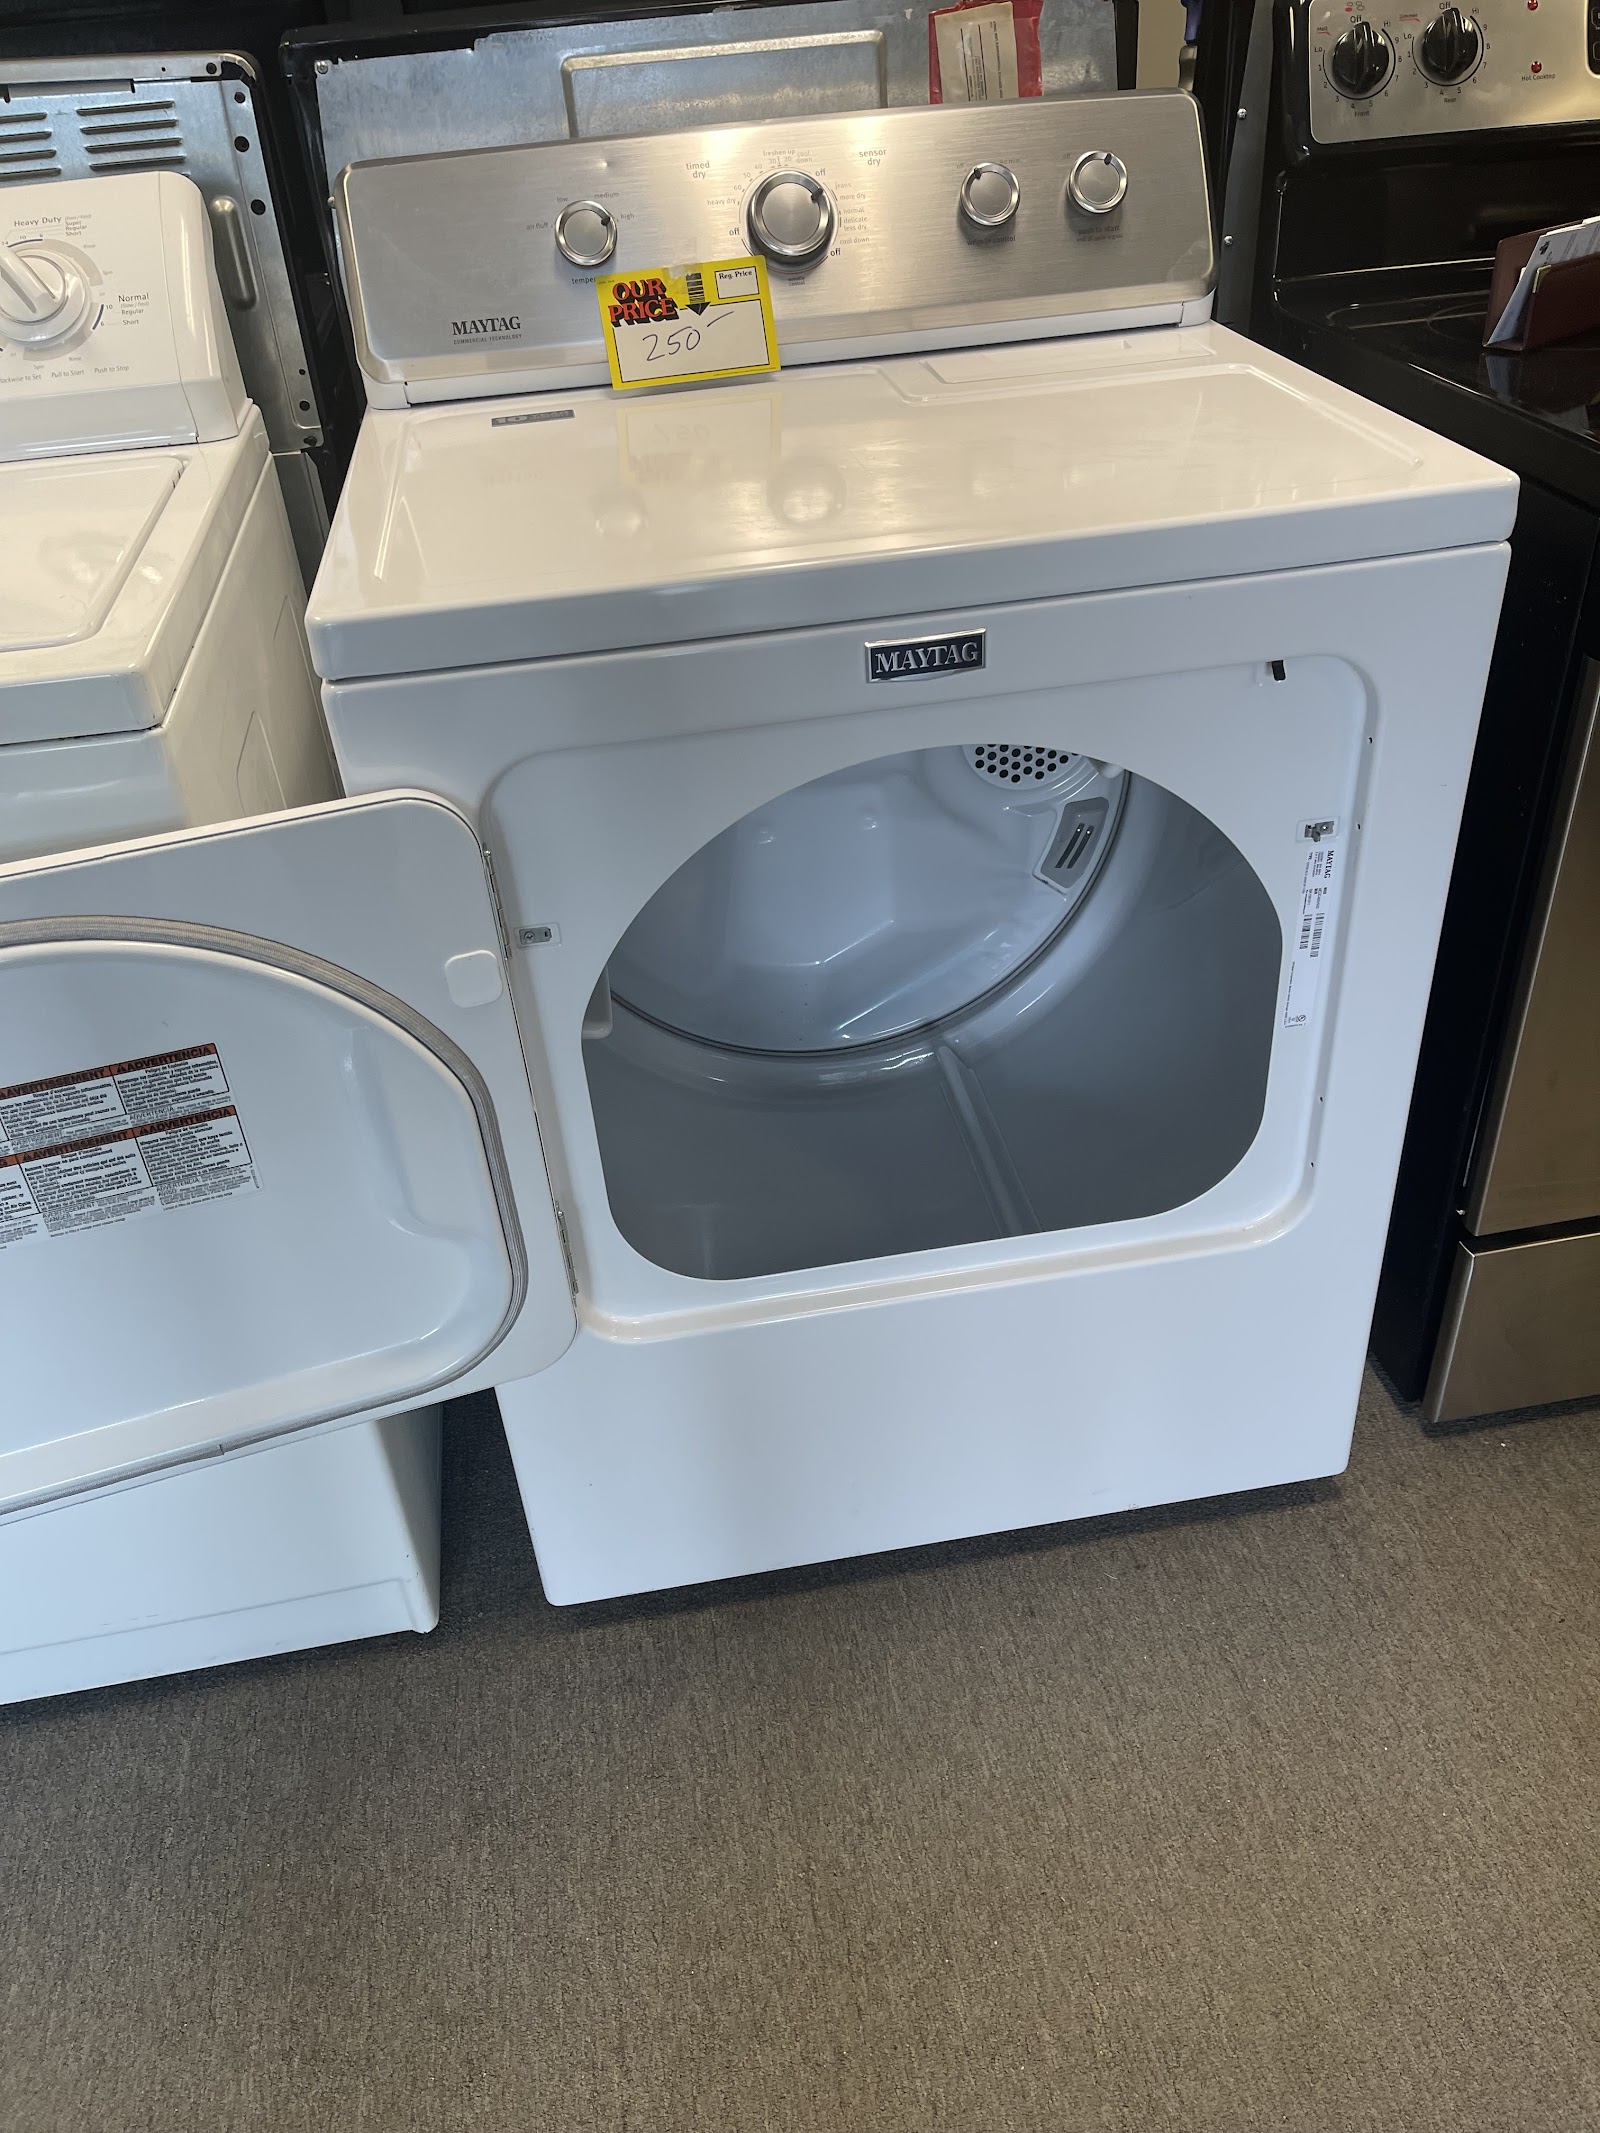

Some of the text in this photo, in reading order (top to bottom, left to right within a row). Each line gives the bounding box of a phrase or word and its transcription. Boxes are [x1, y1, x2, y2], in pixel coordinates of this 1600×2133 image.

[858, 148, 887, 158] sensor
[685, 160, 710, 171] timed
[867, 157, 881, 167] dry
[692, 170, 706, 180] dry
[815, 167, 826, 177] off
[856, 192, 866, 200] dry
[14, 219, 39, 228] Heavy
[41, 216, 62, 224] Duty
[620, 212, 635, 221] high
[843, 215, 868, 225] delicate
[729, 227, 740, 236] off
[853, 236, 870, 244] down
[830, 247, 841, 257] off
[718, 269, 753, 281] Reg. Price
[612, 278, 666, 304] OUR
[118, 292, 150, 303] Normal
[121, 308, 144, 317] Regular
[608, 297, 679, 327] PRICE
[450, 315, 521, 336] MAYTAG
[453, 333, 522, 345] COMMERCIAL TECHNOLOGY
[875, 641, 979, 673] MAYTAG
[1324, 850, 1334, 879] MAYTAG
[127, 1045, 212, 1071] ADVERTENCIA
[7, 1069, 105, 1096] AVERTISSEMENT
[149, 1107, 232, 1133] ADVERTENCIA
[33, 1131, 128, 1158] AVERTISSEMENT
